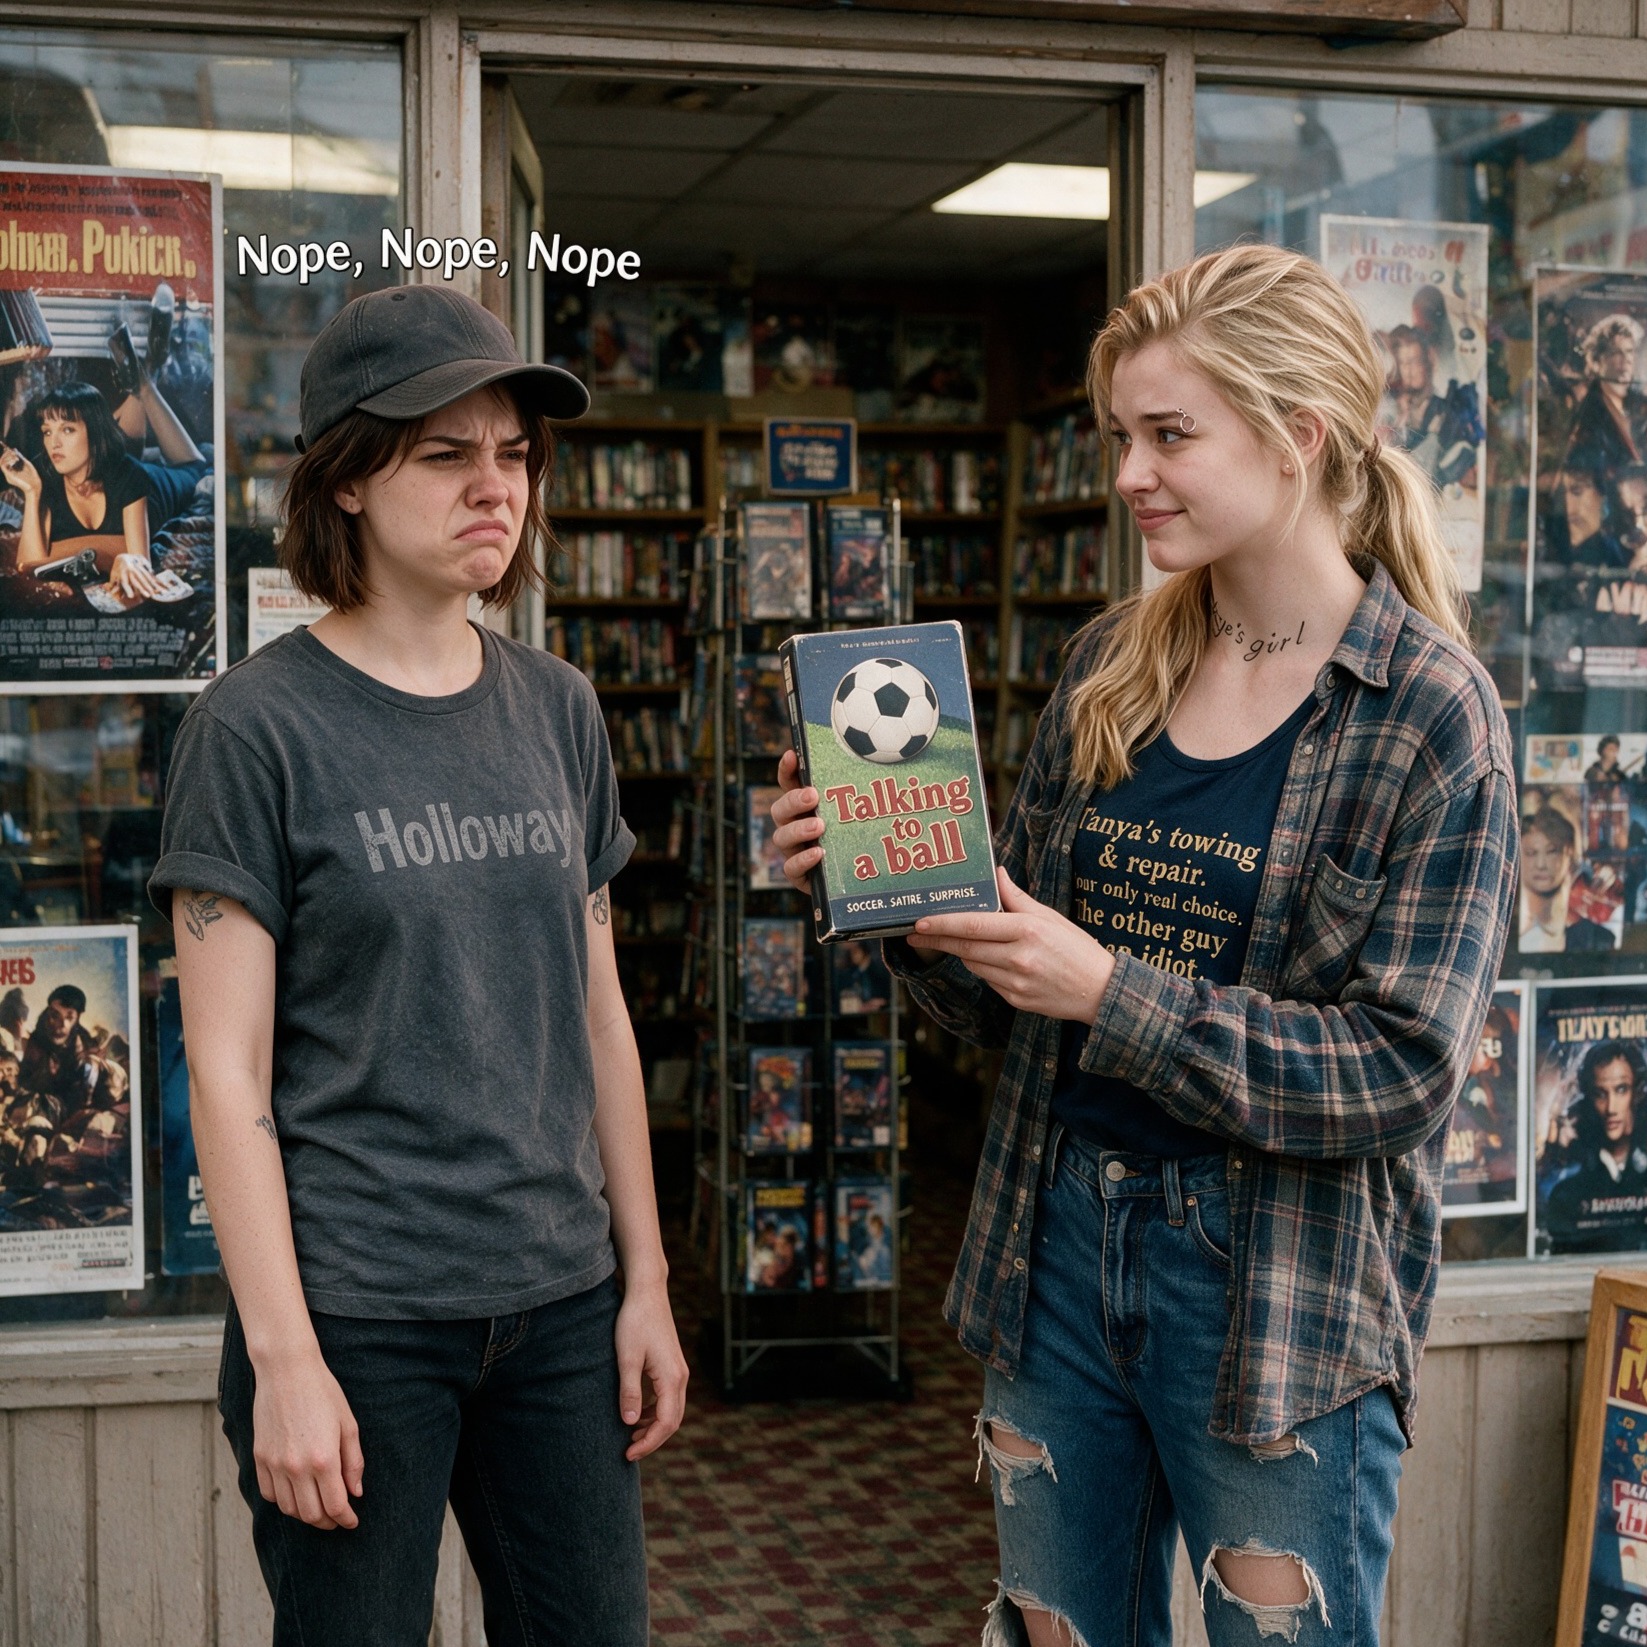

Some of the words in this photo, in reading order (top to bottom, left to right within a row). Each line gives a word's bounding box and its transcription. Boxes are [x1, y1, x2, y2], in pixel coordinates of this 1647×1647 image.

[1243, 621, 1305, 661] girl
[825, 775, 974, 823] Talking
[353, 802, 572, 873] Holloway
[853, 851, 879, 881] a
[881, 819, 968, 876] ball
[891, 817, 923, 841] to
[1079, 806, 1162, 844] Tanya's
[1169, 827, 1261, 873] towing
[1098, 843, 1118, 870] &
[1126, 855, 1206, 887] repair.
[846, 899, 887, 913] SOCCER.
[890, 893, 926, 908] SATIRE.
[929, 887, 980, 902] SURPRISE.
[1075, 875, 1098, 893] our
[1102, 881, 1139, 905] only
[1144, 892, 1177, 911] real
[1182, 895, 1243, 926] choice.
[1112, 911, 1175, 942] other
[1180, 928, 1228, 959] guy
